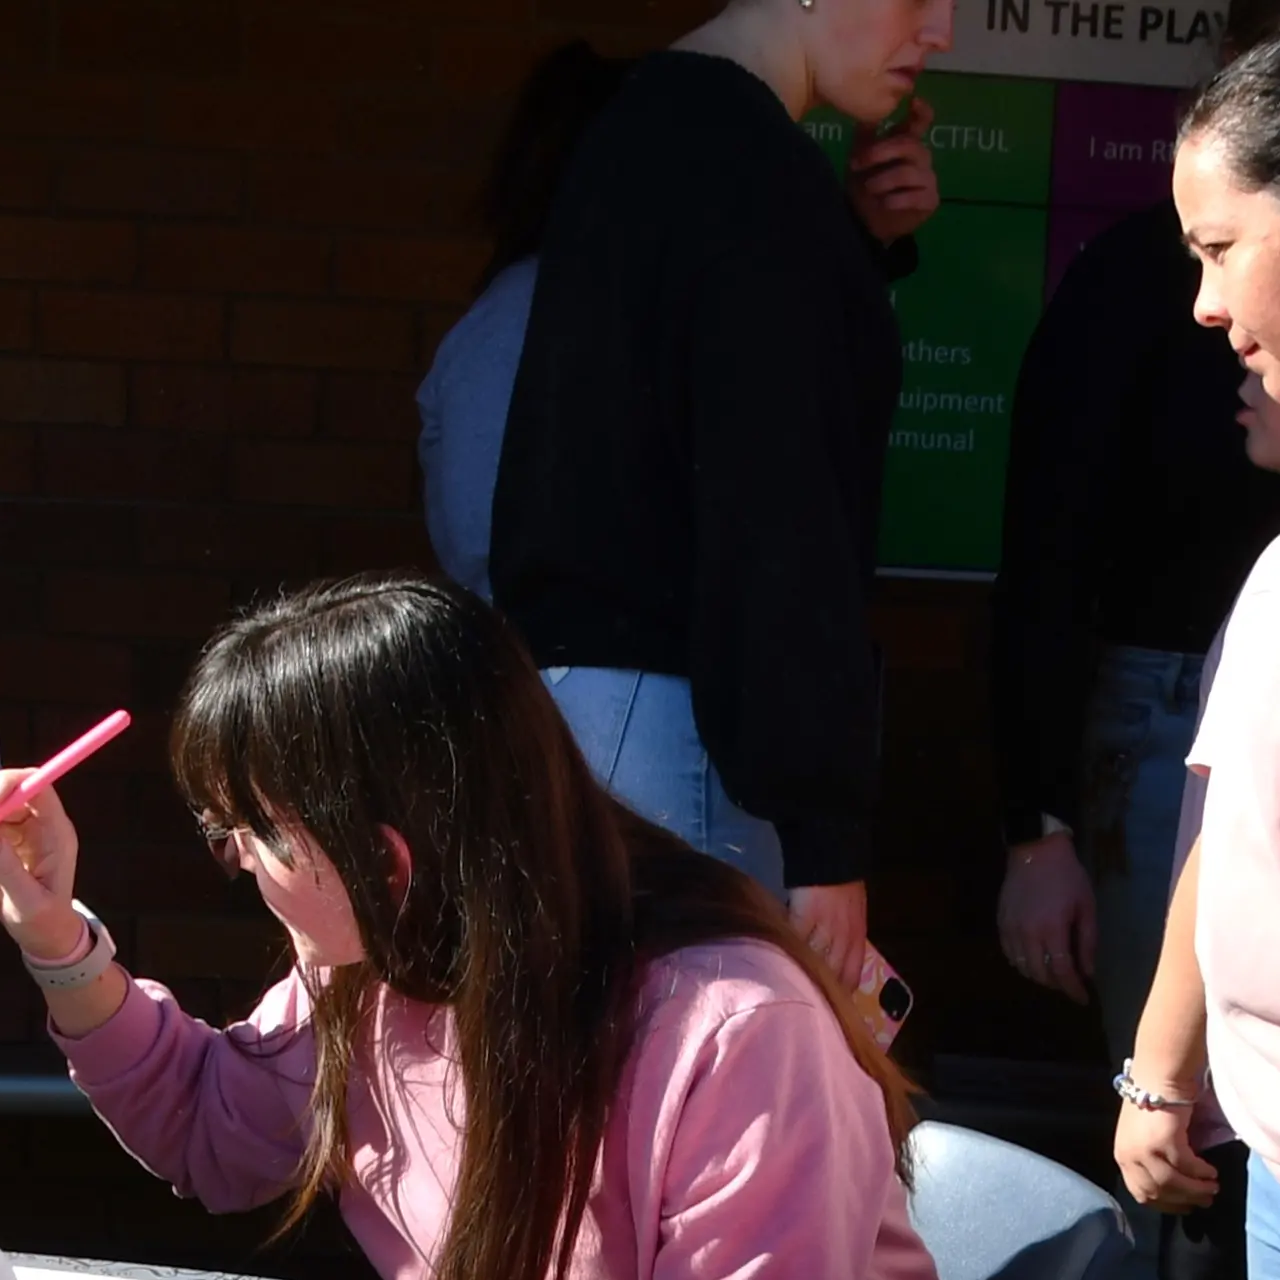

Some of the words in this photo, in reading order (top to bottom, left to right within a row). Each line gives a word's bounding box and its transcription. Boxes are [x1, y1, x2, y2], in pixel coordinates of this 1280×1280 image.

[986, 0, 1030, 33] IN
[1044, 0, 1124, 40] THE
[1103, 141, 1142, 161] am
[898, 386, 1007, 415] uipment
[888, 429, 975, 452] munal
